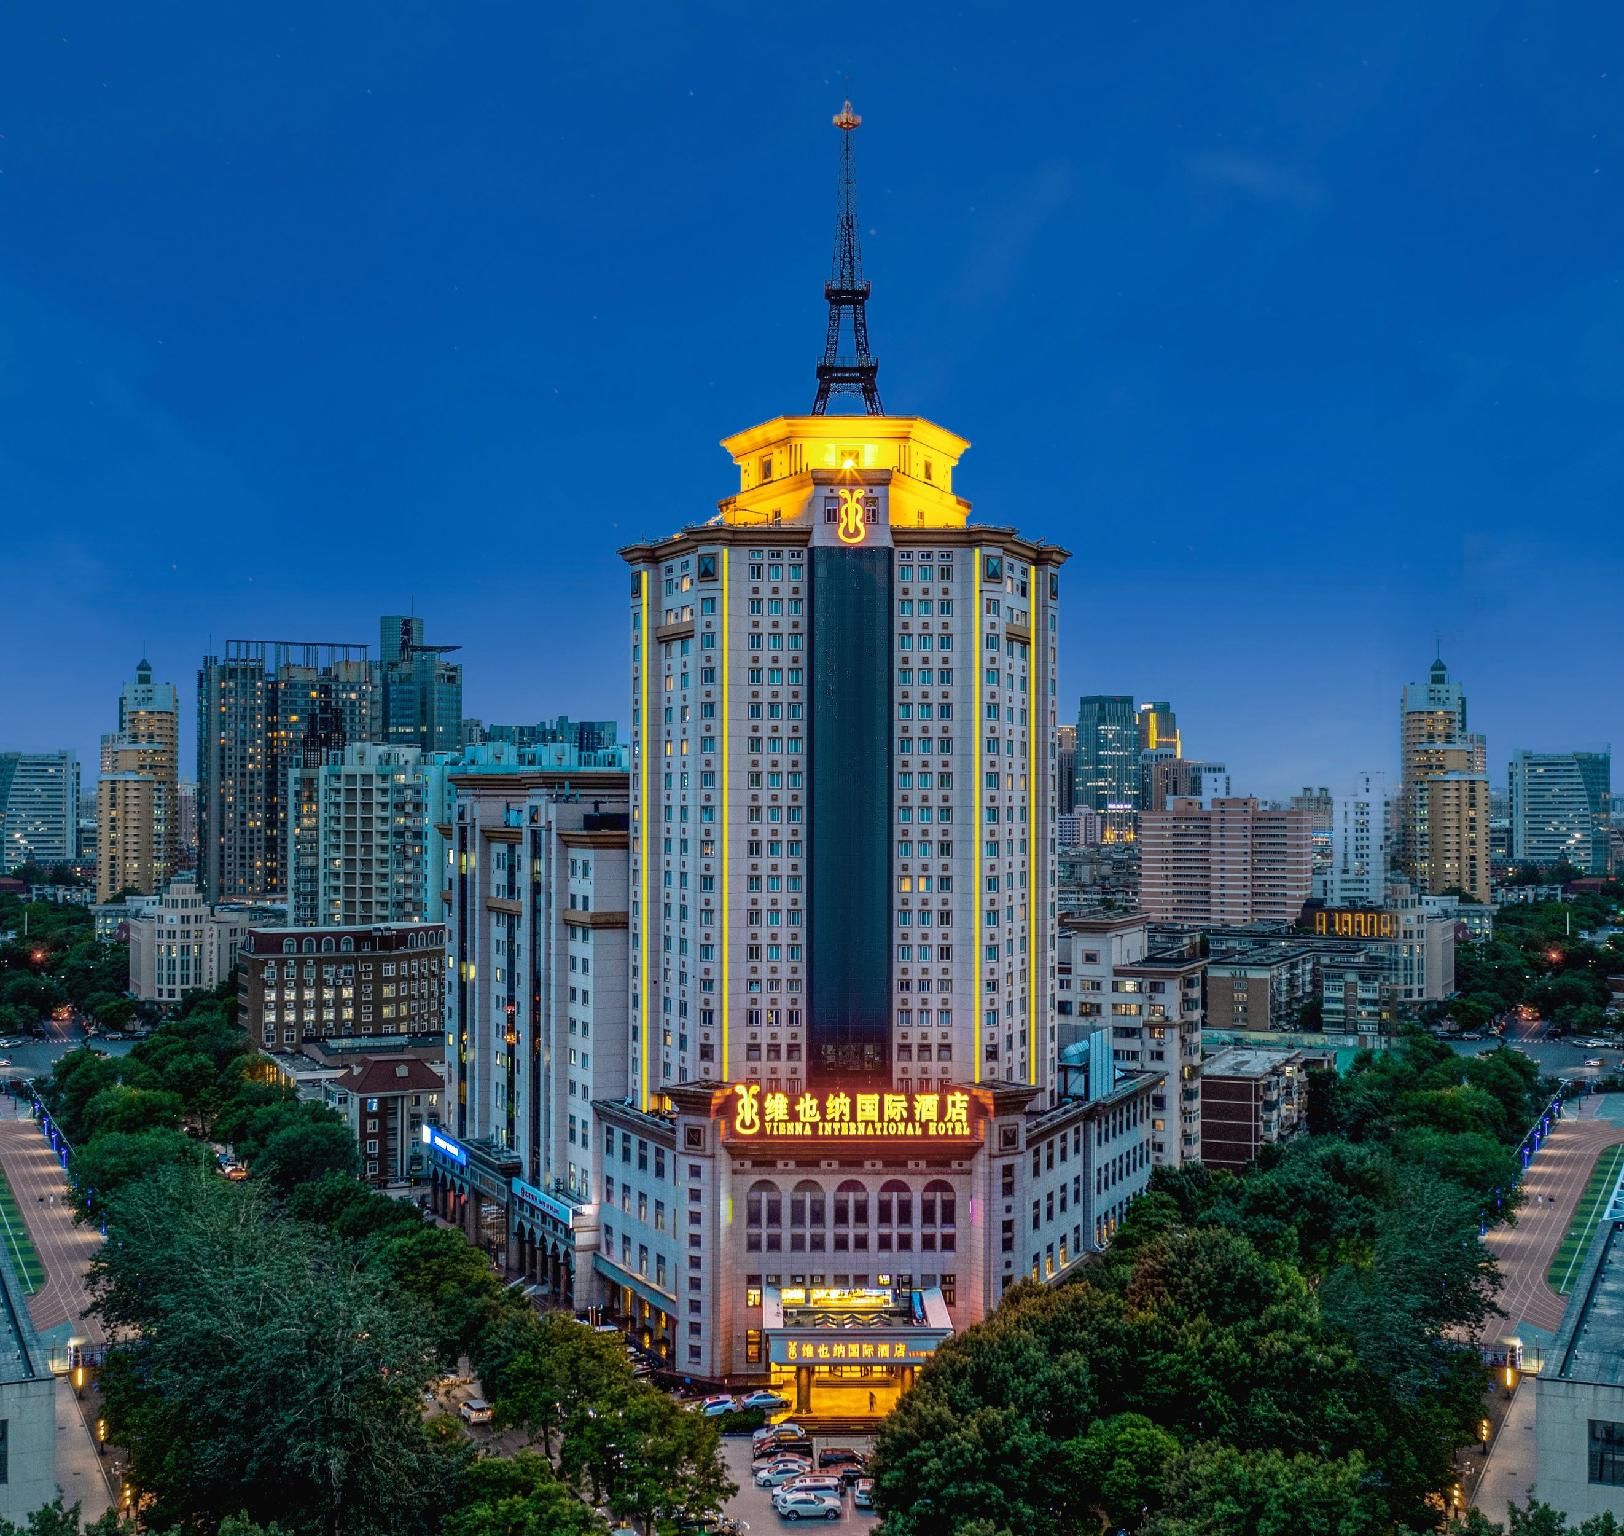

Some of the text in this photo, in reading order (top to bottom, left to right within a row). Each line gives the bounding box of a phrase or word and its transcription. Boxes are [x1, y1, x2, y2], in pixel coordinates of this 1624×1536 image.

[764, 1092, 970, 1122] 维也纳国际酒店
[764, 1122, 970, 1136] VIENNA INTERNATIONAL HOTEL
[801, 1343, 906, 1358] 维也纳国际酒店
